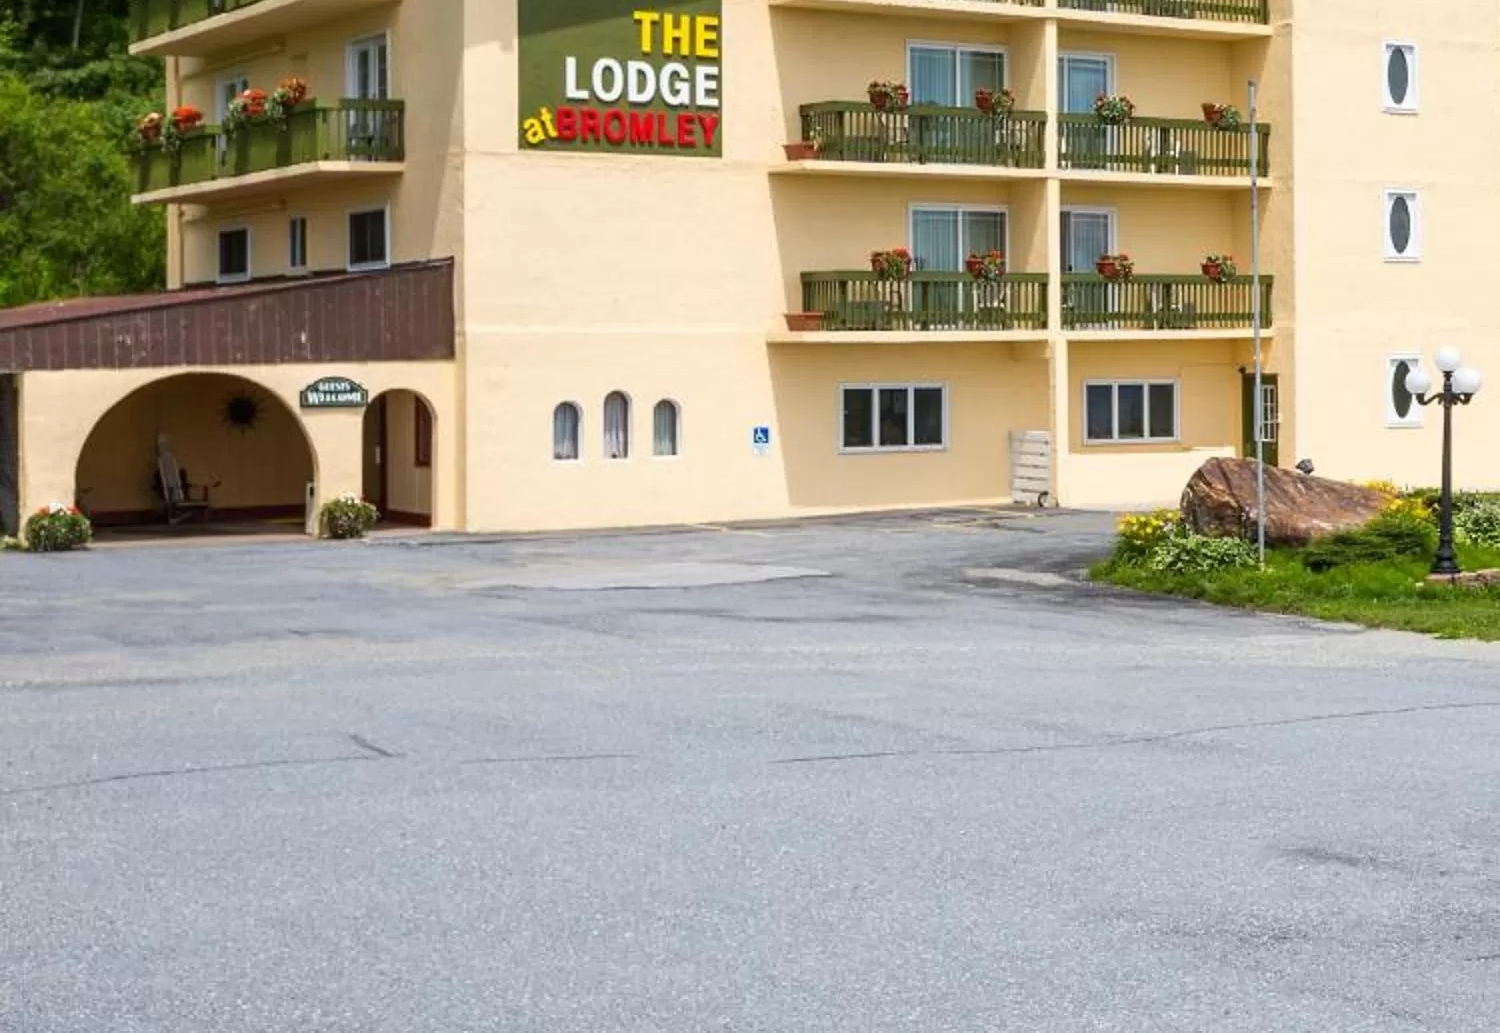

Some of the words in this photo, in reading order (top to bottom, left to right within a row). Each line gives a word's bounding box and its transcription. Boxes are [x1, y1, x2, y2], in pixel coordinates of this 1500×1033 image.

[633, 10, 720, 58] THE
[565, 56, 720, 107] LODGE
[523, 106, 558, 144] at
[556, 107, 718, 147] BROMLEY
